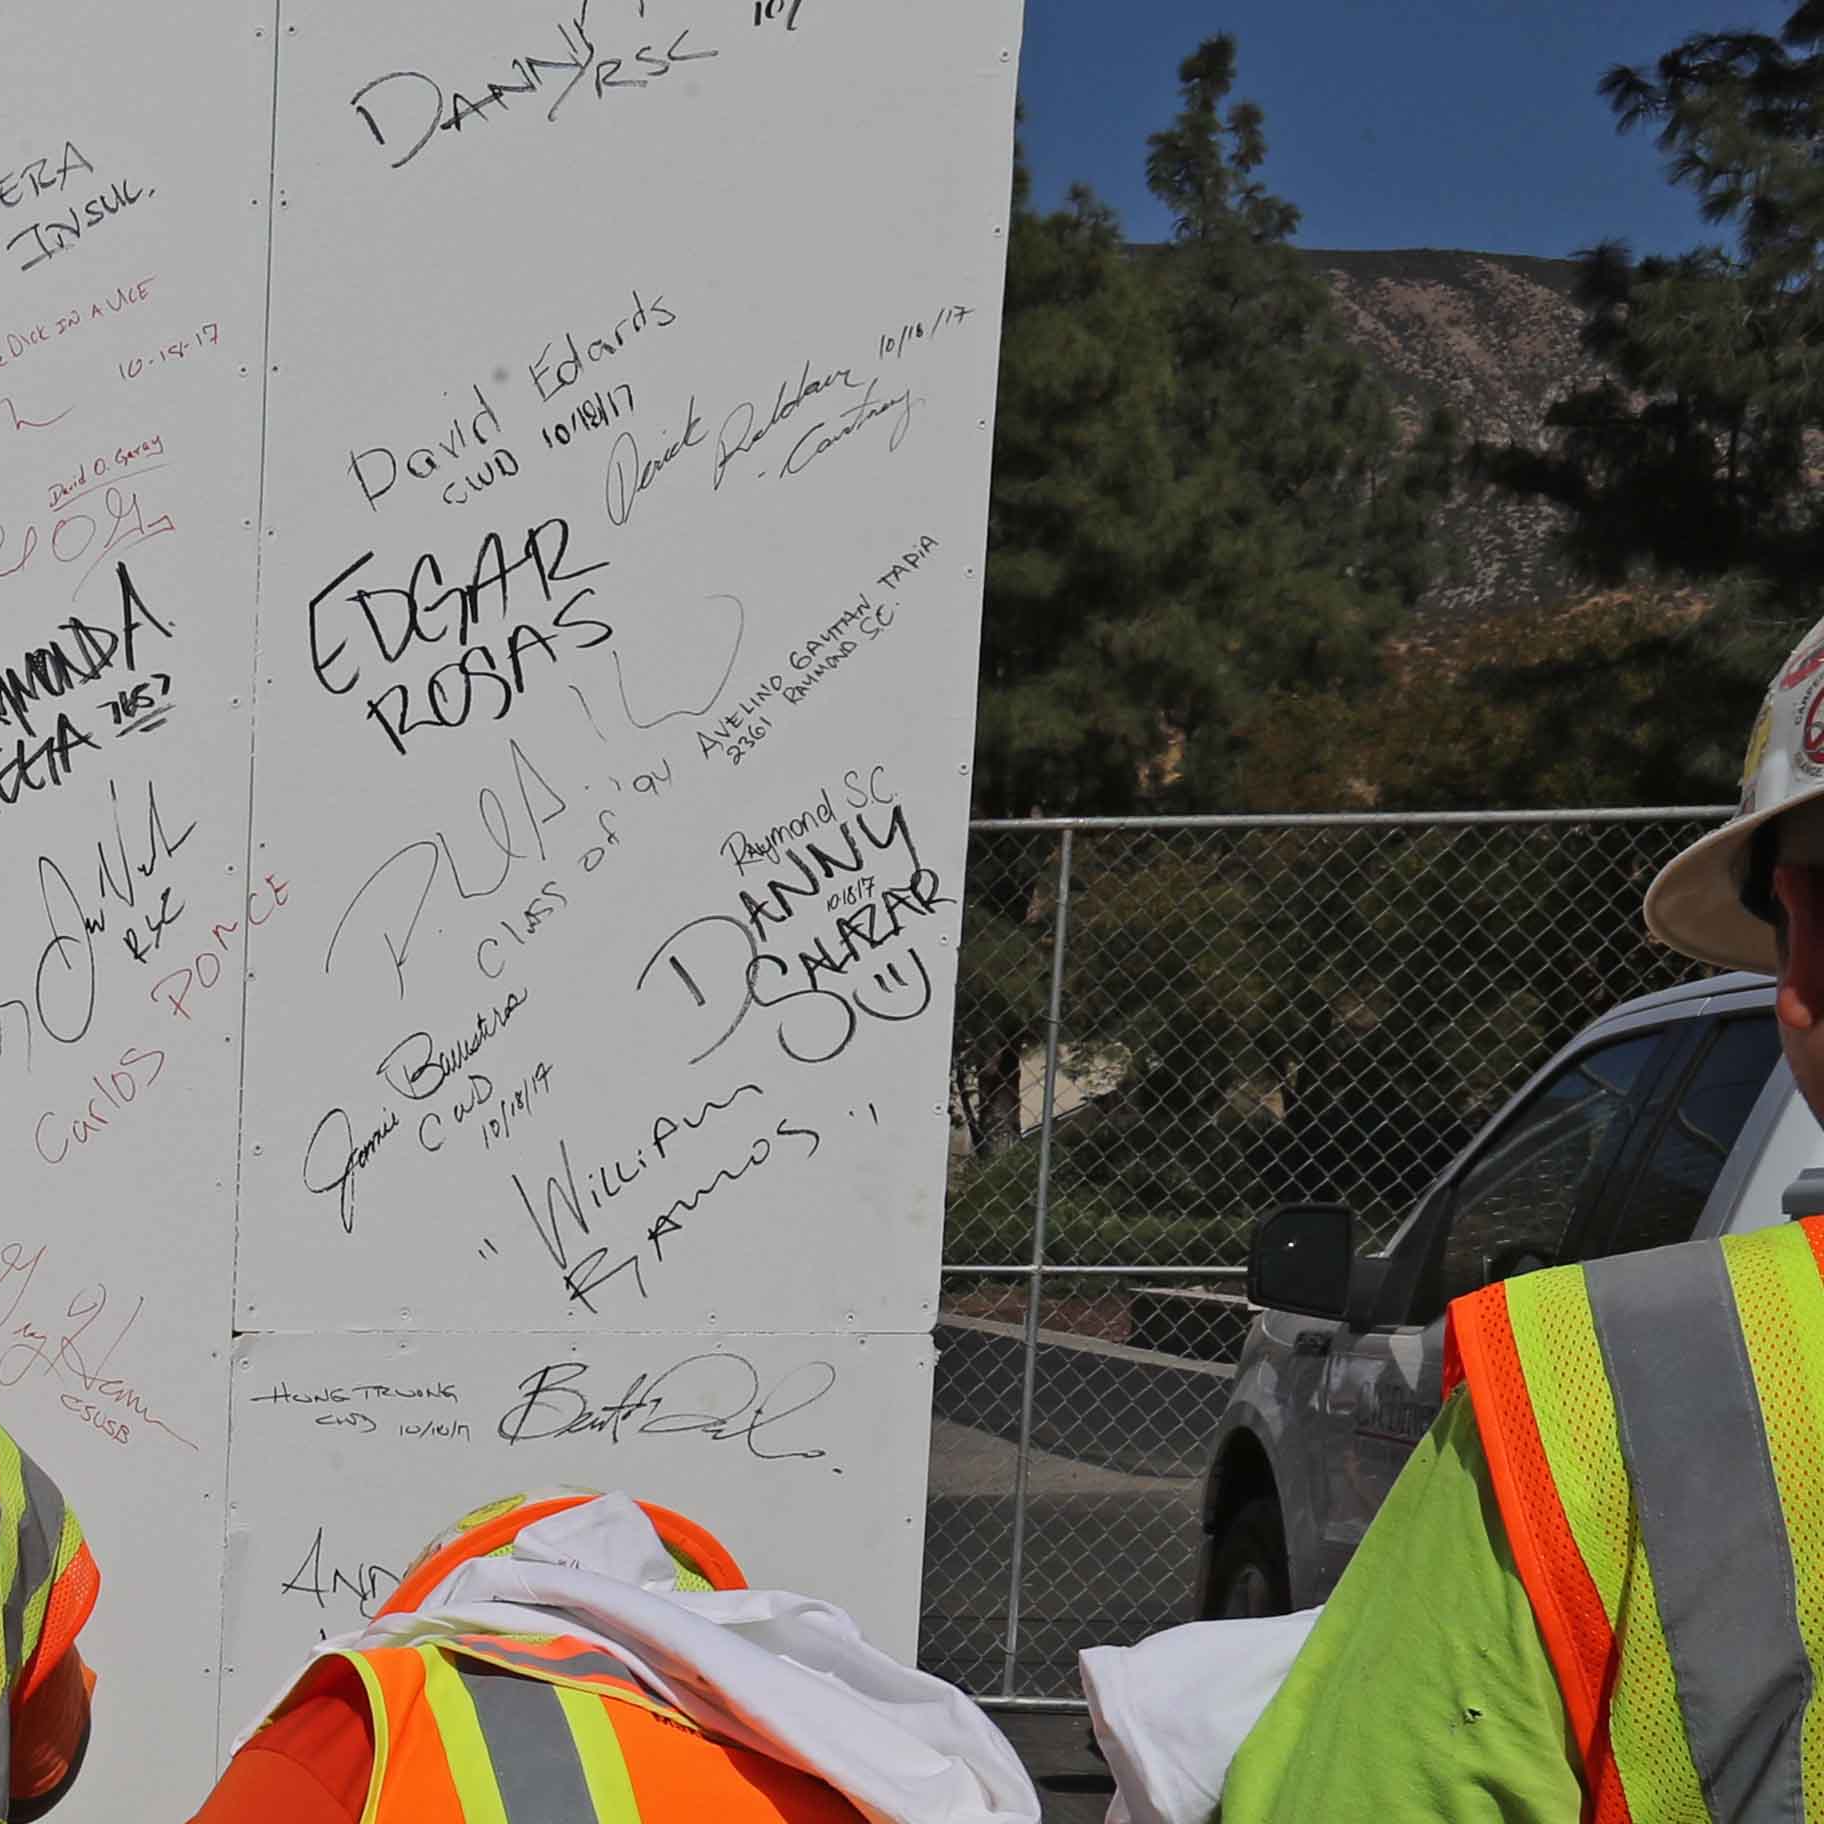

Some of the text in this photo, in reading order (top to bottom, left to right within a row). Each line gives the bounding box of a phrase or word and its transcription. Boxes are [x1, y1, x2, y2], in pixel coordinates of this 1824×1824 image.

[348, 383, 502, 512] David
[308, 517, 611, 696] EDGAR
[365, 586, 614, 756] ROSAS
[695, 674, 783, 760] AVELINO
[781, 639, 858, 705] RAYMOND
[34, 1046, 166, 1168] Carlos
